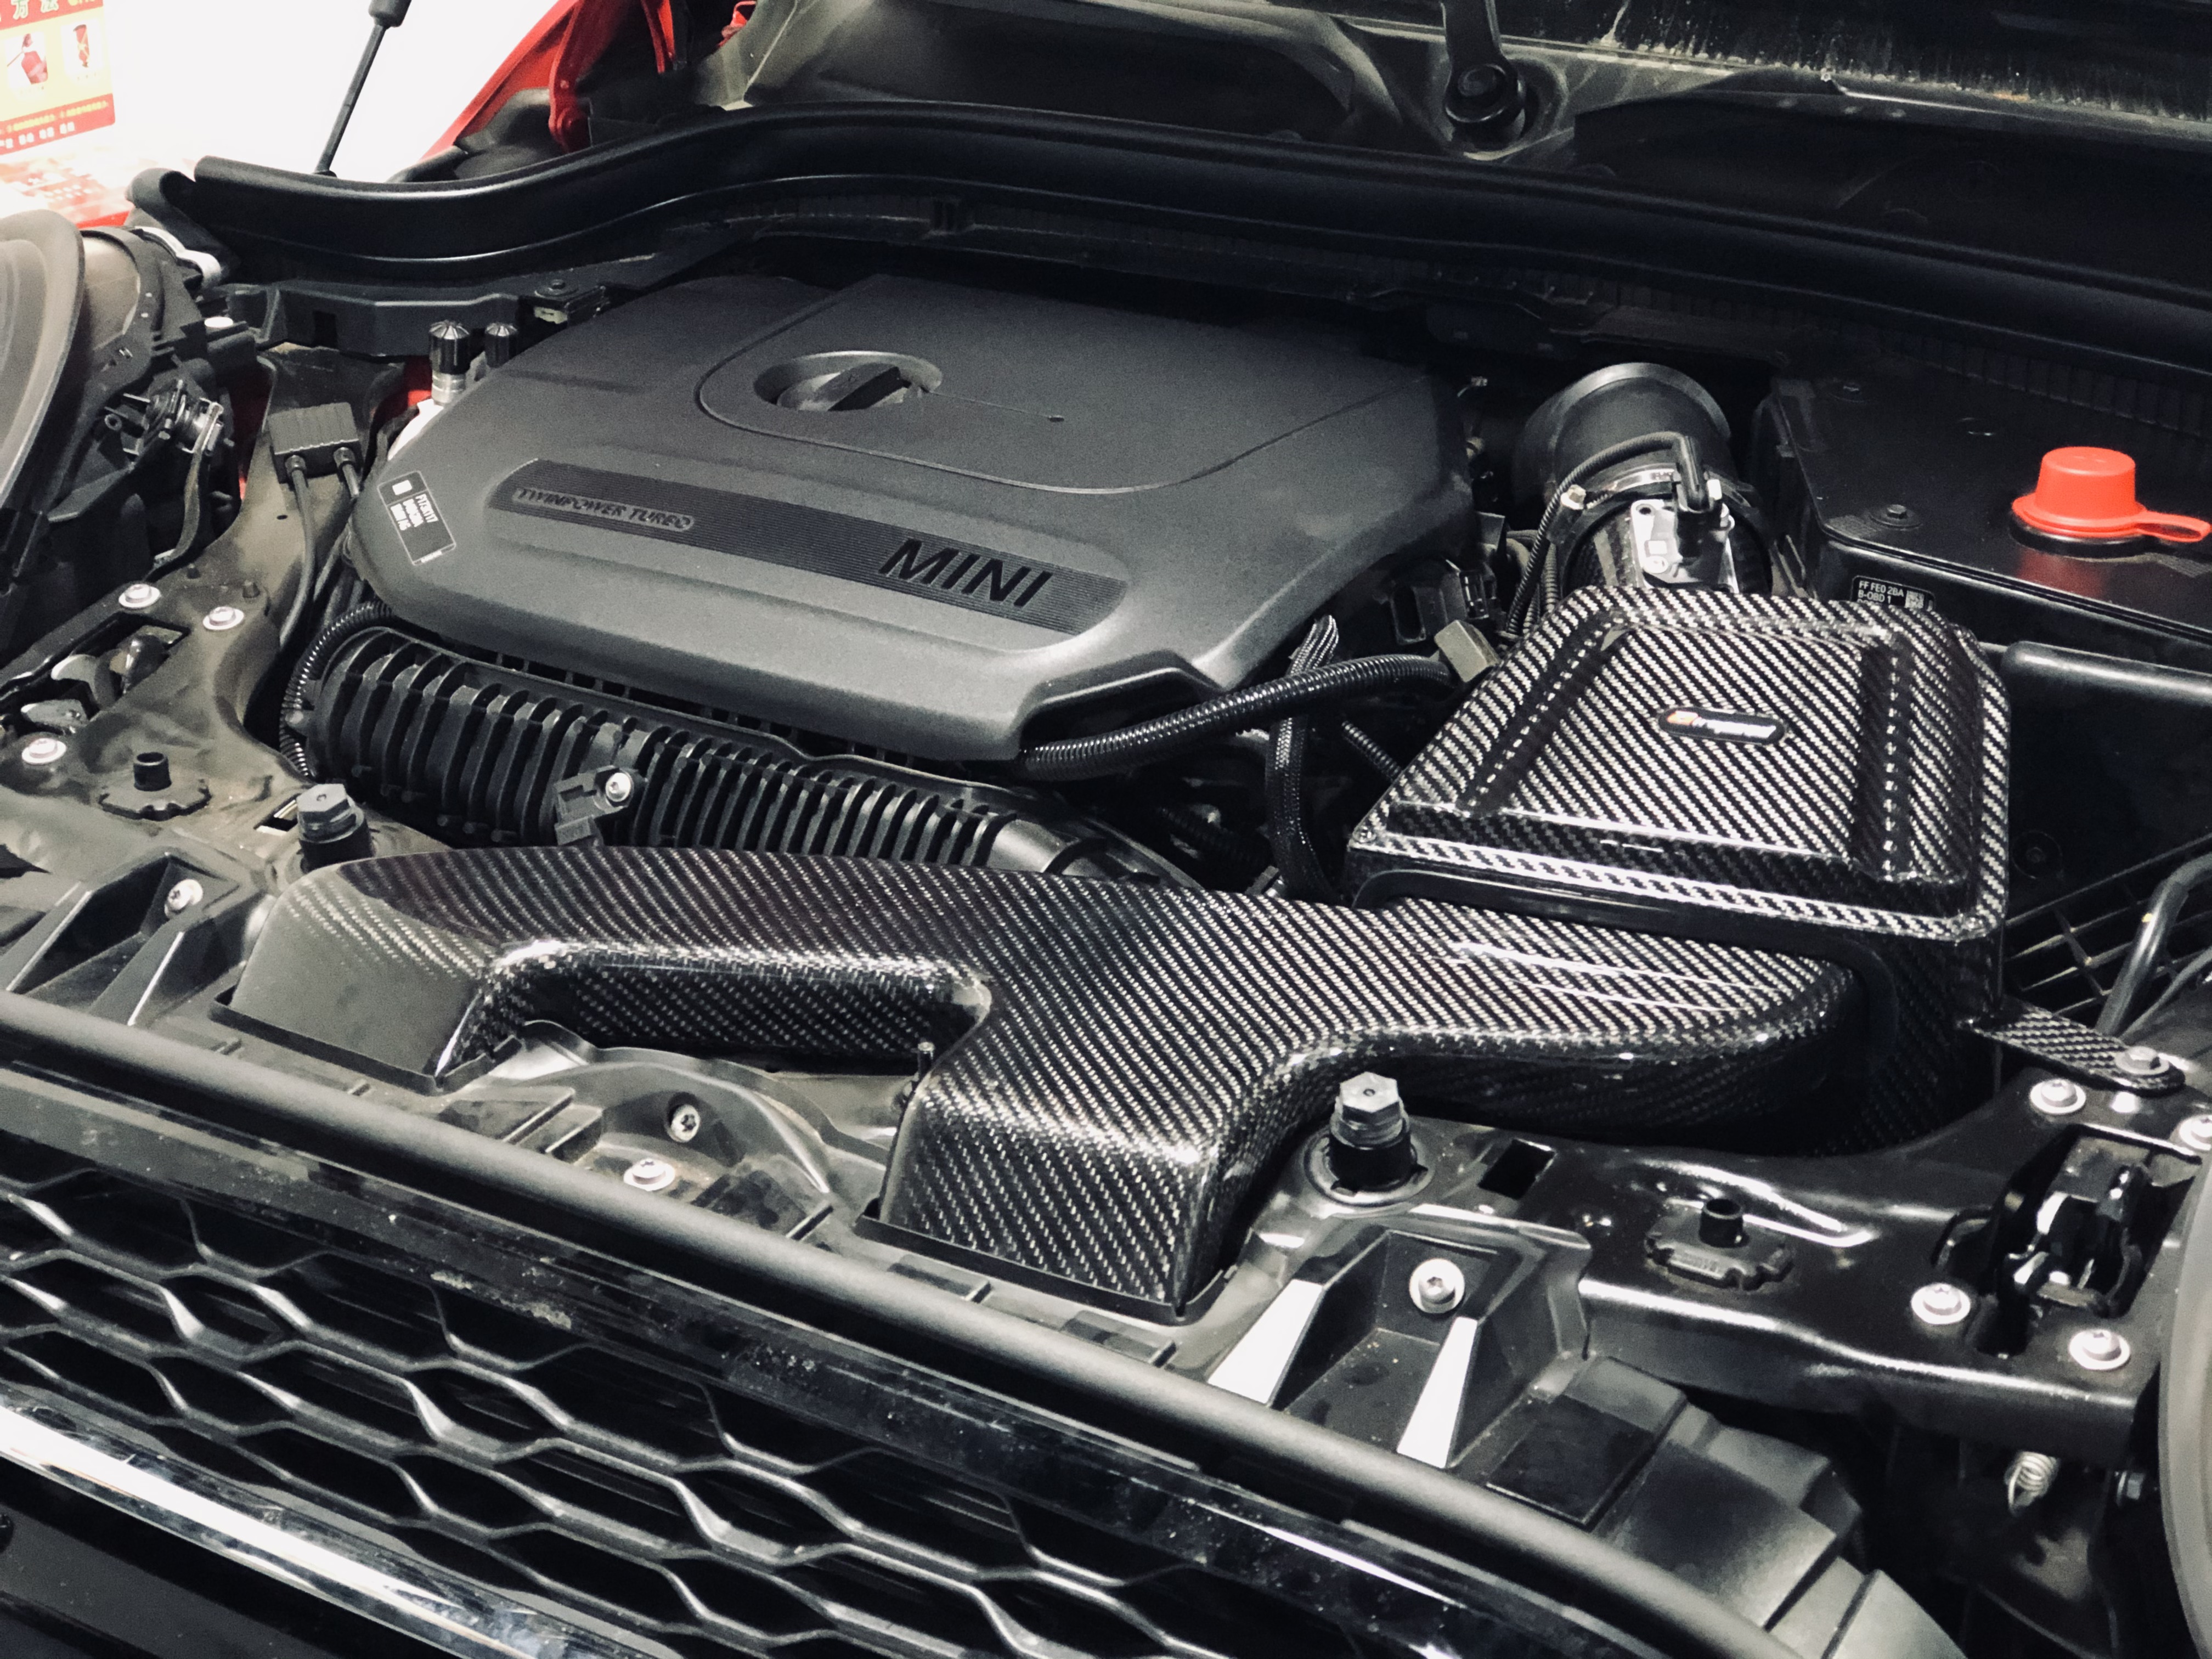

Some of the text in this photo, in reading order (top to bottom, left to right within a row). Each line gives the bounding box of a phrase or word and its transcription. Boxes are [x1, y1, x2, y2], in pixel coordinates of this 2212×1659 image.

[518, 488, 691, 528] TWINPOWER TURBO
[878, 538, 1053, 607] MINI
[1859, 580, 1869, 589] FF
